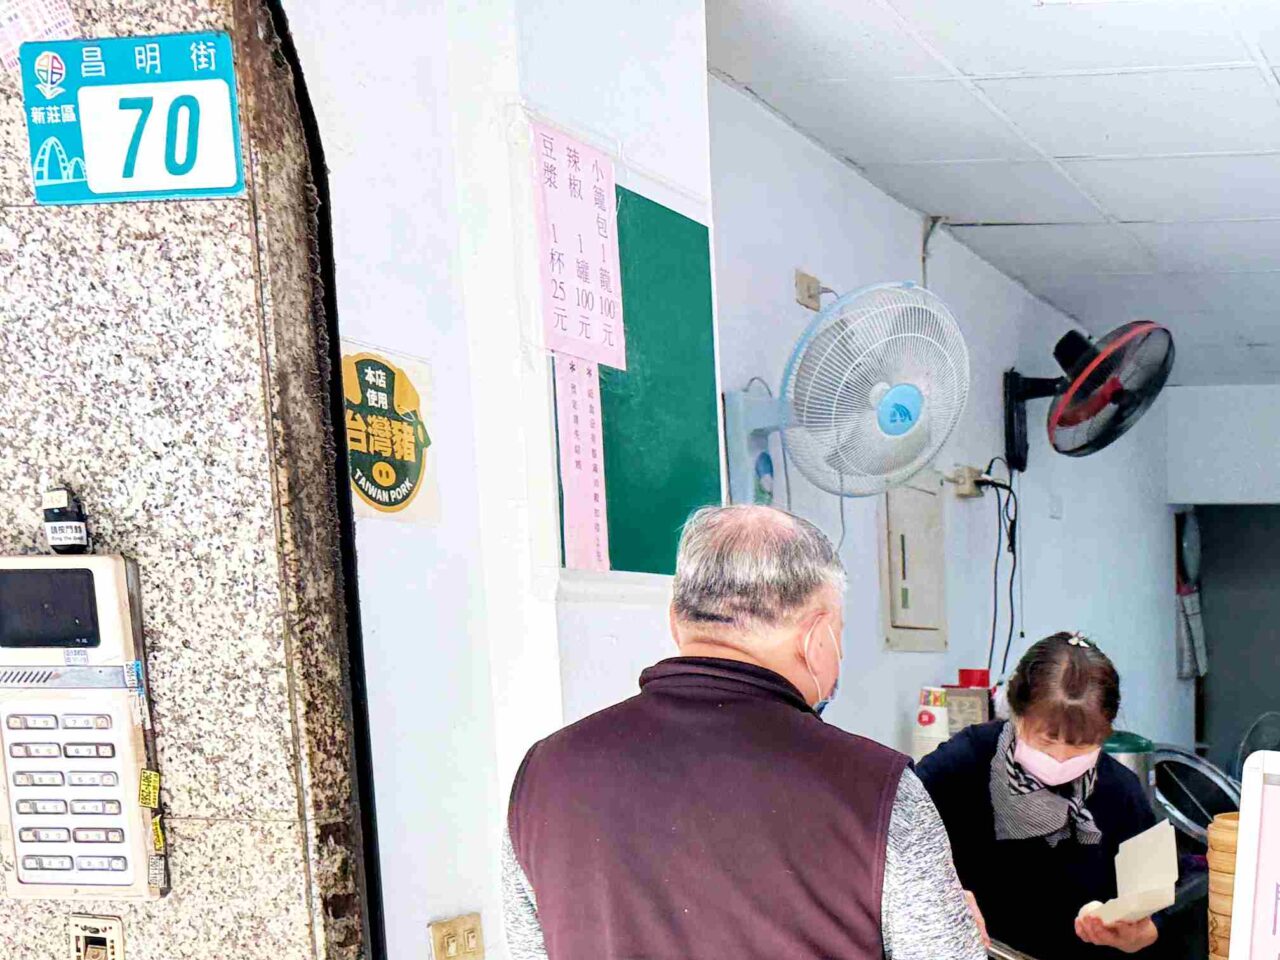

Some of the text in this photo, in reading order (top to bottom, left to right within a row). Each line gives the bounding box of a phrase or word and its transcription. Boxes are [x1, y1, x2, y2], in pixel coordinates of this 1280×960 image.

[81, 41, 216, 77] 昌明街
[30, 104, 77, 125] 新莊區
[118, 94, 200, 179] 70
[566, 145, 583, 200] 辣椒
[364, 366, 387, 388] 本店
[366, 389, 389, 410] 使用
[346, 409, 416, 462] 台灣豬
[354, 468, 414, 502] TAIWAN PORK
